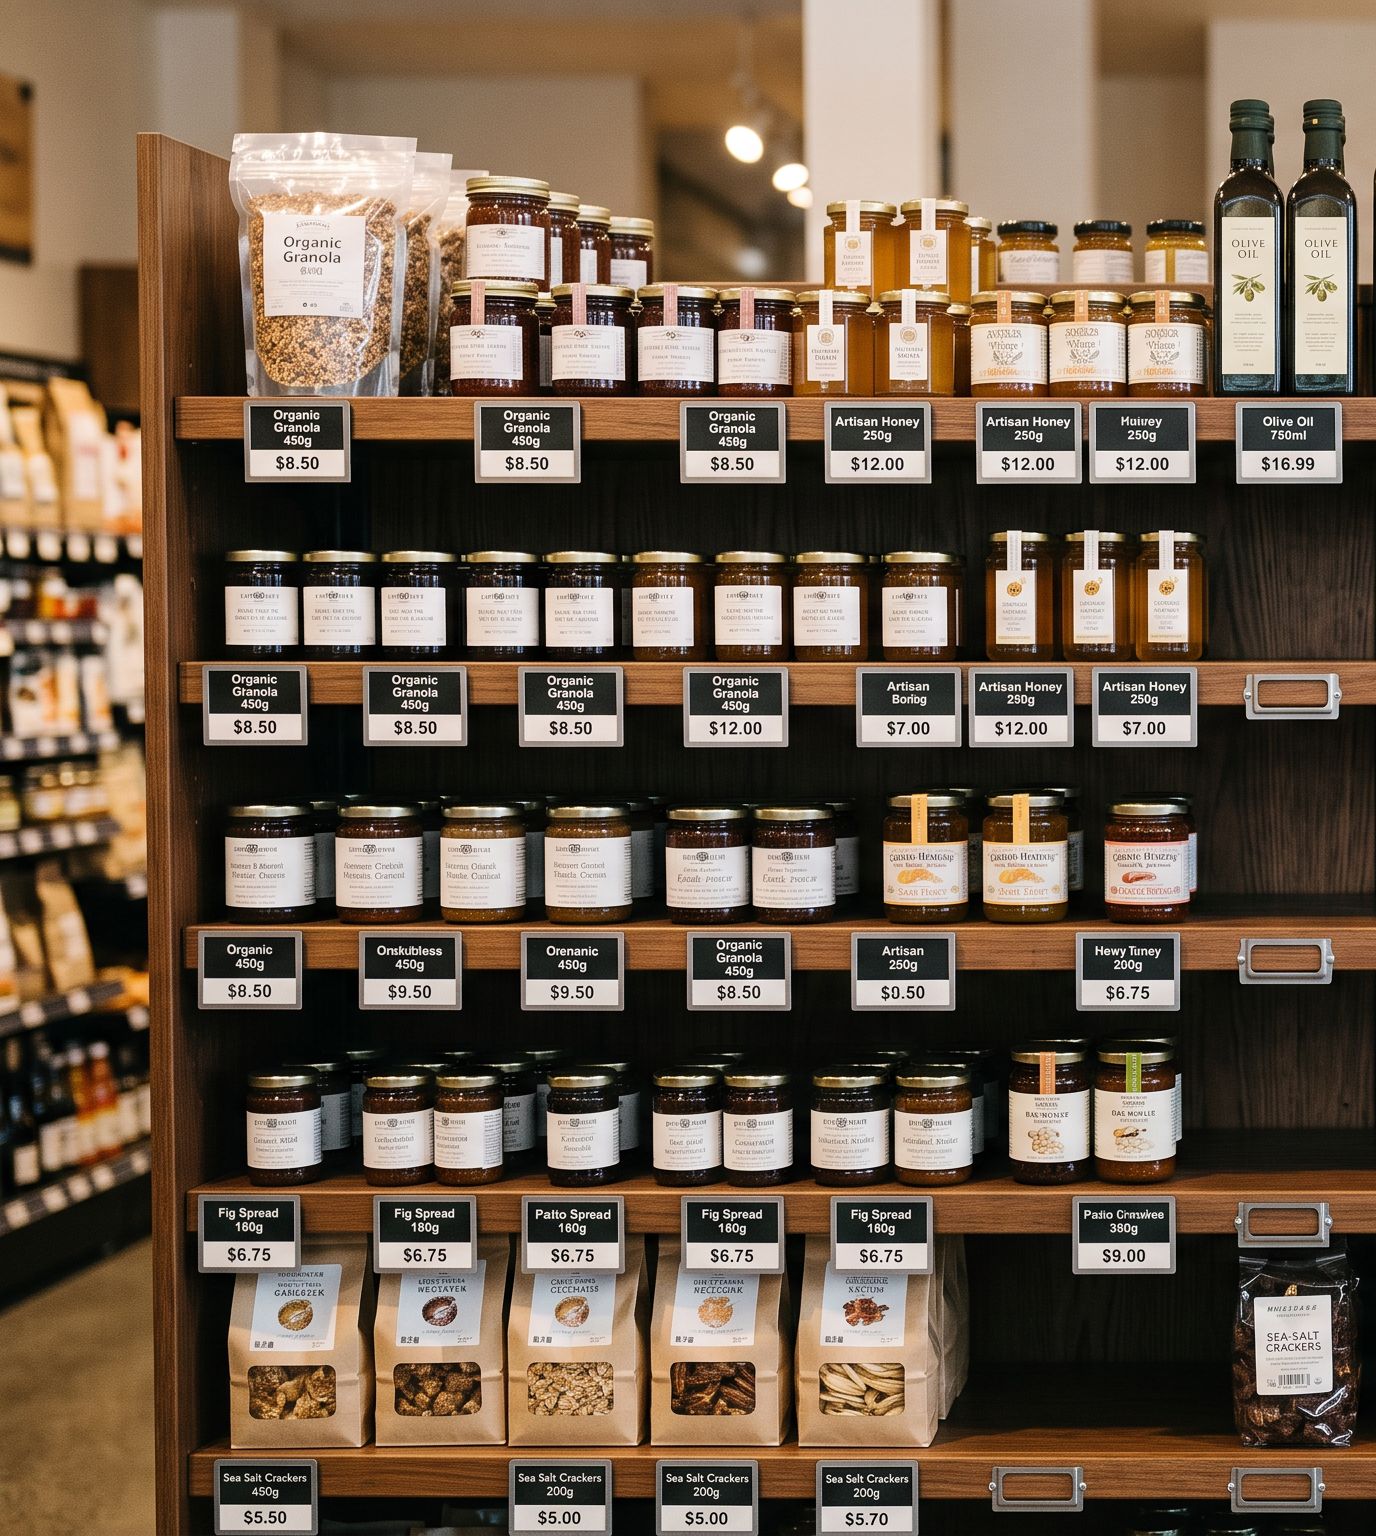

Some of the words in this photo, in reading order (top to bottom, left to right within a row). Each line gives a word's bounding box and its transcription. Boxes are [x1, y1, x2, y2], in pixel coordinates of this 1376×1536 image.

[284, 236, 341, 252] Organic
[284, 251, 340, 263] Granola
[1238, 250, 1258, 258] OIL
[1311, 250, 1330, 258] OIL
[274, 410, 320, 422] Organic
[835, 416, 878, 426] Artisan
[882, 416, 920, 429] Honey
[986, 417, 1029, 426] Artisan
[1033, 416, 1071, 429] Honey
[1263, 416, 1293, 426] Olive
[1297, 416, 1313, 426] Oil
[274, 422, 320, 432] Granola
[284, 435, 311, 448] 450g
[863, 430, 891, 443] 250g
[1014, 430, 1043, 443] 250g
[1271, 430, 1306, 440] 750ml
[275, 455, 320, 472] $8.50
[850, 456, 904, 472] $12.00
[1001, 456, 1055, 472] $12.00
[1261, 456, 1315, 472] $16.99
[232, 674, 277, 686] Organic
[392, 675, 438, 687] Organic
[712, 676, 759, 688] Organic
[233, 687, 277, 696] Granola
[393, 687, 438, 697] Granola
[713, 688, 759, 698] Granola
[1103, 681, 1145, 691] Artisan
[1149, 681, 1187, 694] Honey
[241, 699, 268, 711] 450g
[401, 700, 429, 712] 450g
[1131, 694, 1158, 706] 250g
[233, 719, 277, 735] $8.50
[394, 720, 437, 736] $8.50
[709, 720, 762, 736] $12.00
[1122, 720, 1166, 736] $7.00
[227, 944, 272, 957] Organic
[546, 946, 598, 956] Orenanic
[716, 940, 762, 952] Organic
[882, 946, 924, 956] Artisan
[235, 958, 264, 971] 450g
[716, 953, 762, 963] Granola
[395, 959, 424, 972] 450g
[725, 966, 753, 978] 450g
[889, 959, 917, 972] 250g
[227, 983, 272, 1000] $8.50
[388, 984, 432, 1001] $9.50
[550, 984, 594, 1001] $9.50
[717, 984, 761, 1002] $8.50
[1106, 985, 1150, 1002] $6.75
[219, 1208, 235, 1220] Fig
[239, 1208, 278, 1220] Spread
[395, 1208, 412, 1221] Fig
[415, 1208, 454, 1221] Spread
[570, 1209, 611, 1221] Spread
[702, 1209, 719, 1221] Fig
[723, 1209, 762, 1221] Spread
[227, 1246, 271, 1263] $6.75
[403, 1247, 447, 1263] $6.75
[551, 1248, 595, 1264] $6.75
[710, 1248, 754, 1263] $6.75
[1267, 1331, 1320, 1343] SEA-SALT
[1266, 1342, 1321, 1352] CRACKERS
[224, 1473, 241, 1482] Sea
[265, 1473, 307, 1482] Crackers
[519, 1473, 535, 1482] Sea
[539, 1473, 556, 1482] Salt
[560, 1473, 601, 1482] Crackers
[666, 1474, 683, 1482] Sea
[686, 1473, 704, 1482] Salt
[707, 1473, 749, 1483] Crackers
[826, 1474, 843, 1483] Sea
[867, 1474, 909, 1483] Crackers
[252, 1487, 278, 1499] 450g
[547, 1486, 573, 1499] 200g
[694, 1487, 719, 1499] 200g
[854, 1488, 879, 1500] 200g
[243, 1510, 287, 1526] $5.50
[537, 1510, 581, 1526] $5.00
[684, 1511, 728, 1526] $5.00
[845, 1512, 889, 1527] $5.70
